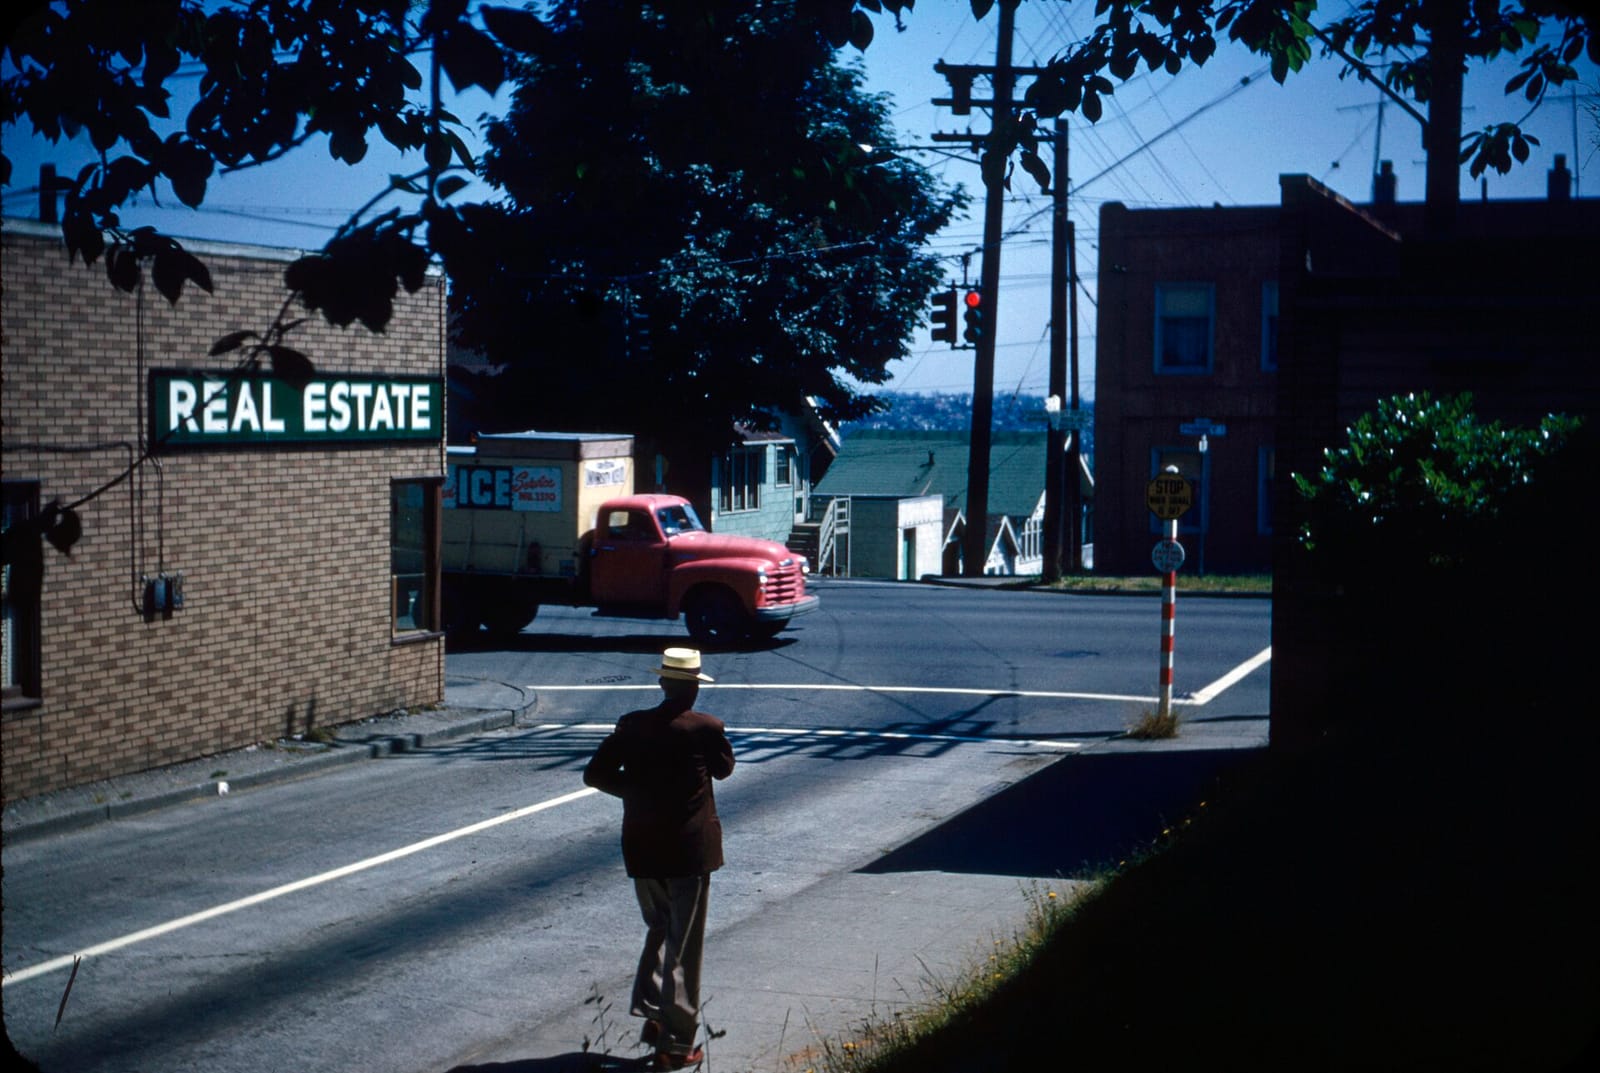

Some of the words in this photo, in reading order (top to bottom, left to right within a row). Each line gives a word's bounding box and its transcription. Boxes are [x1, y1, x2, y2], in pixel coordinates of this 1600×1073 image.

[169, 380, 285, 433] REAL
[303, 381, 431, 432] ESTATE
[459, 469, 510, 506] ICE
[1156, 480, 1184, 494] STOP
